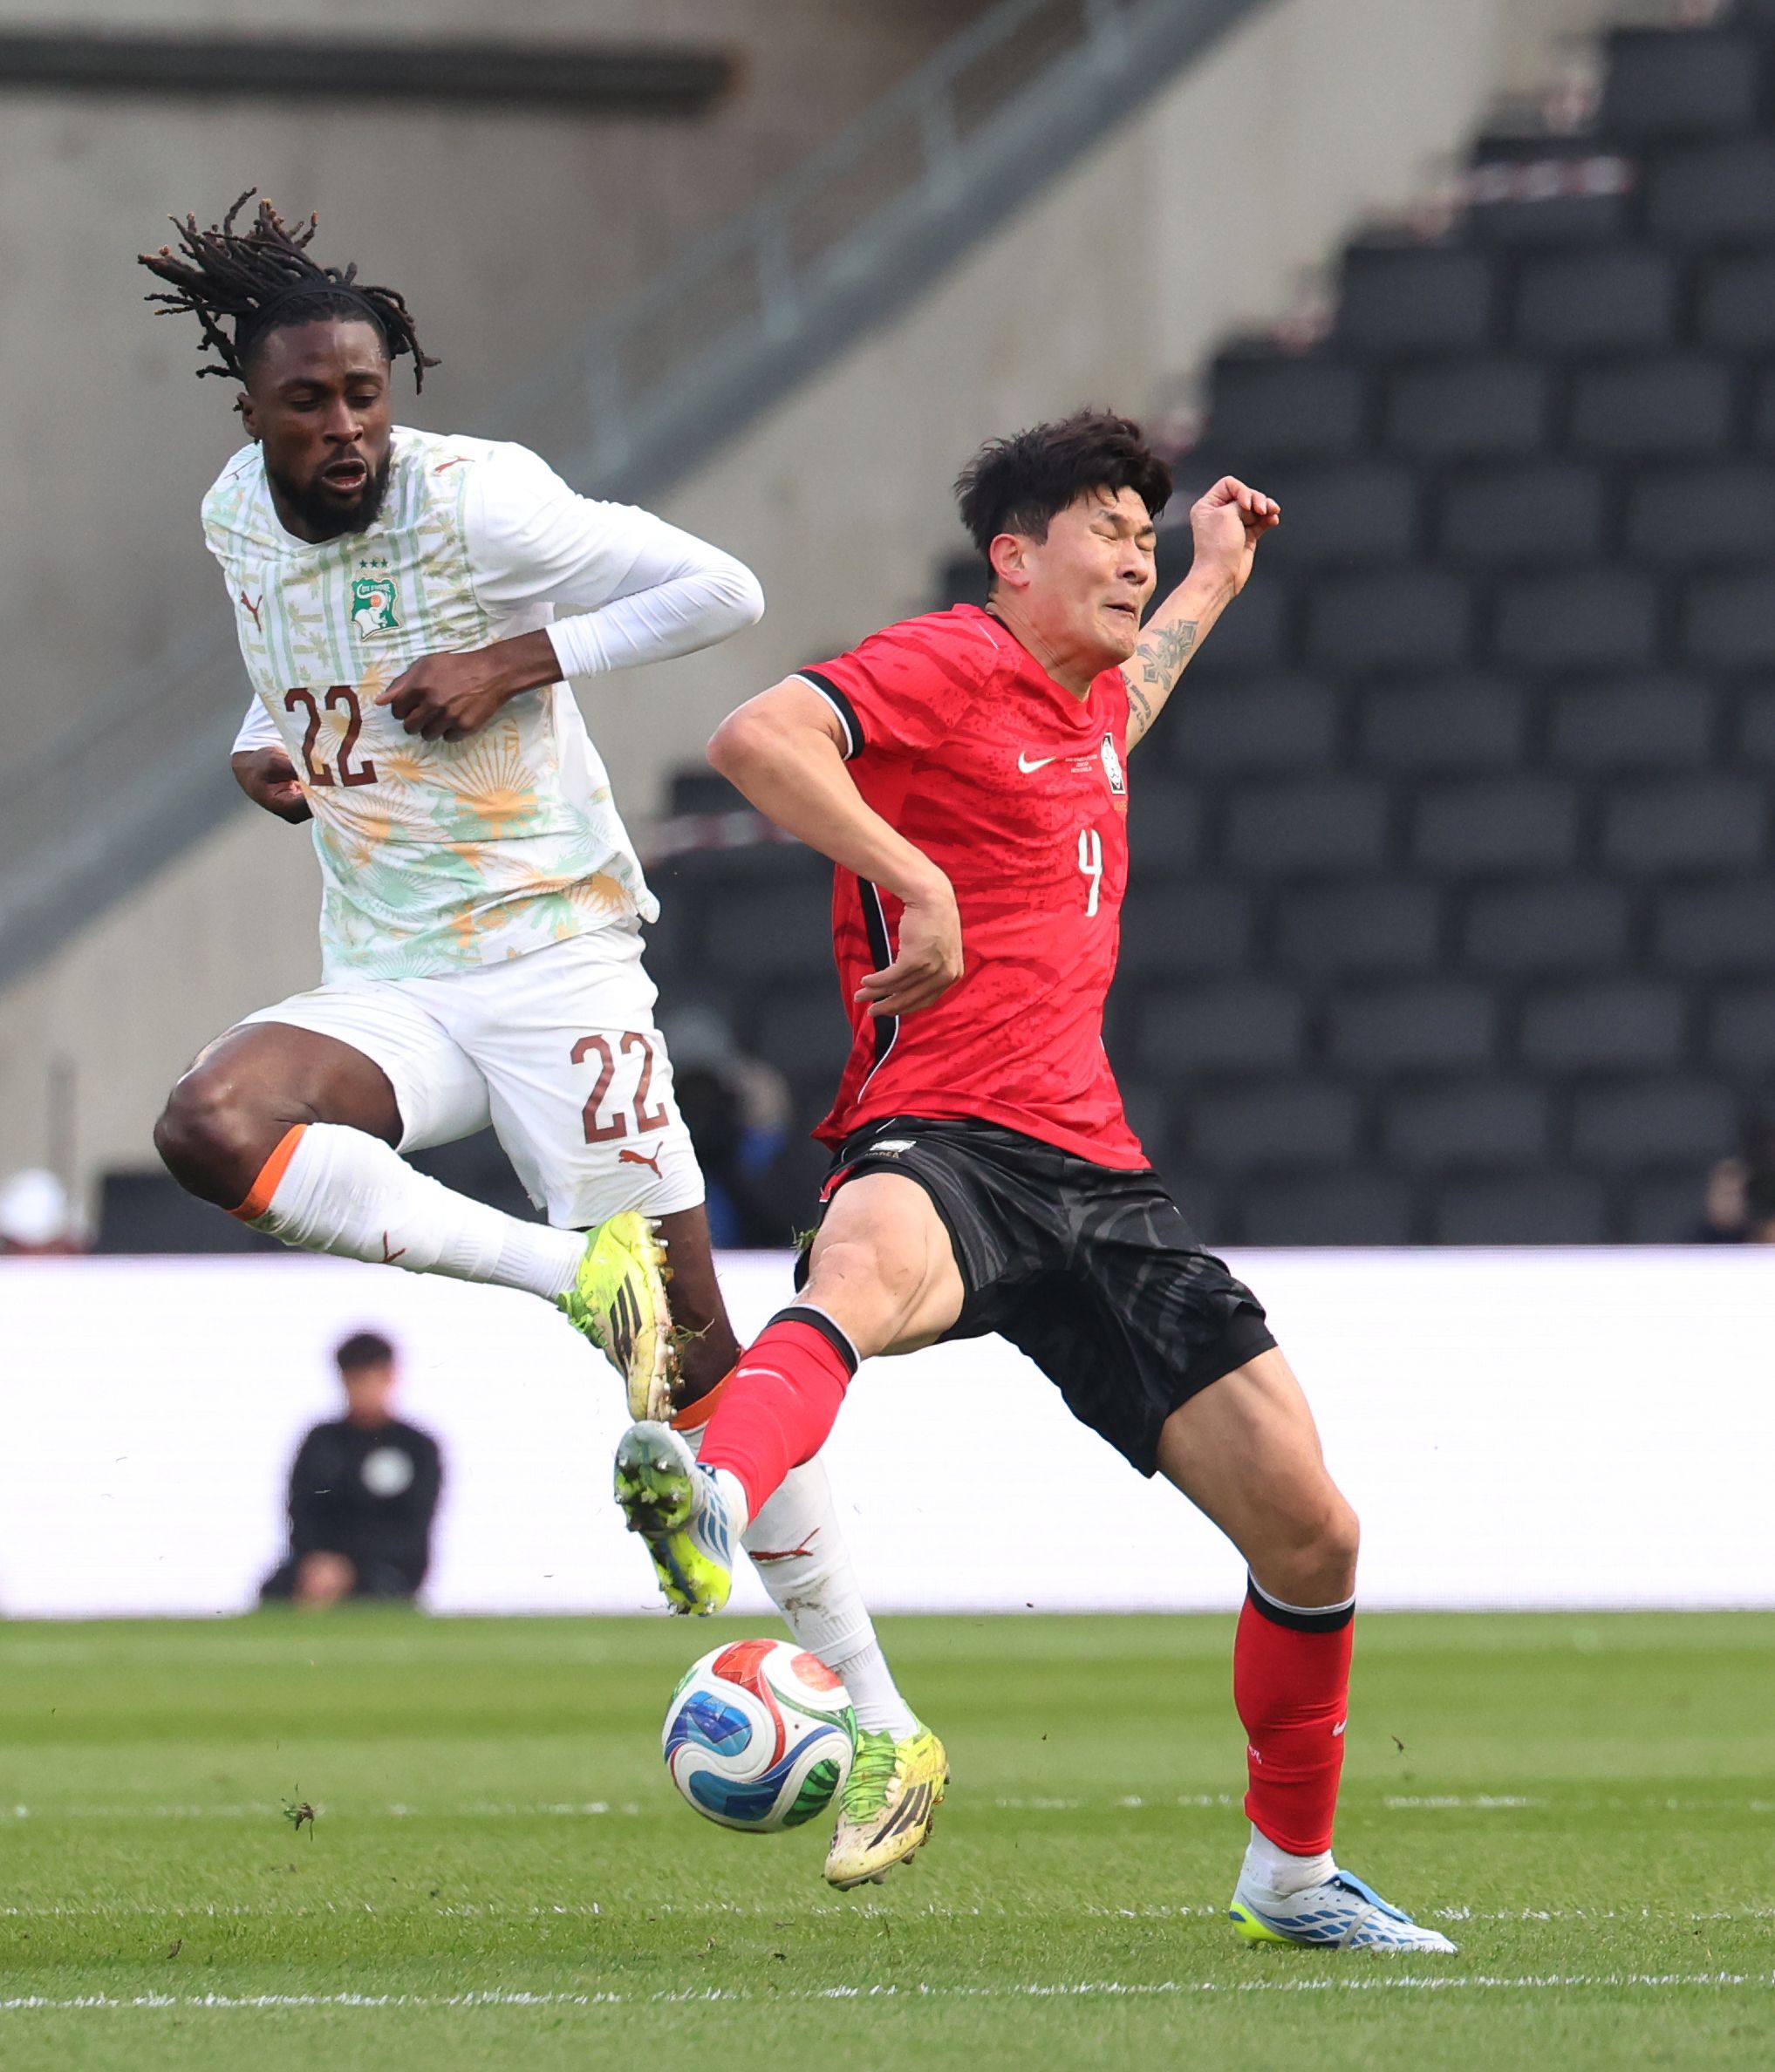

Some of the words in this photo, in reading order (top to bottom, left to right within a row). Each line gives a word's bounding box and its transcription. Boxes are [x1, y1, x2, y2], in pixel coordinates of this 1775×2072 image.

[284, 685, 378, 787] 22
[1078, 828, 1103, 917] 4
[570, 1031, 670, 1144] 22
